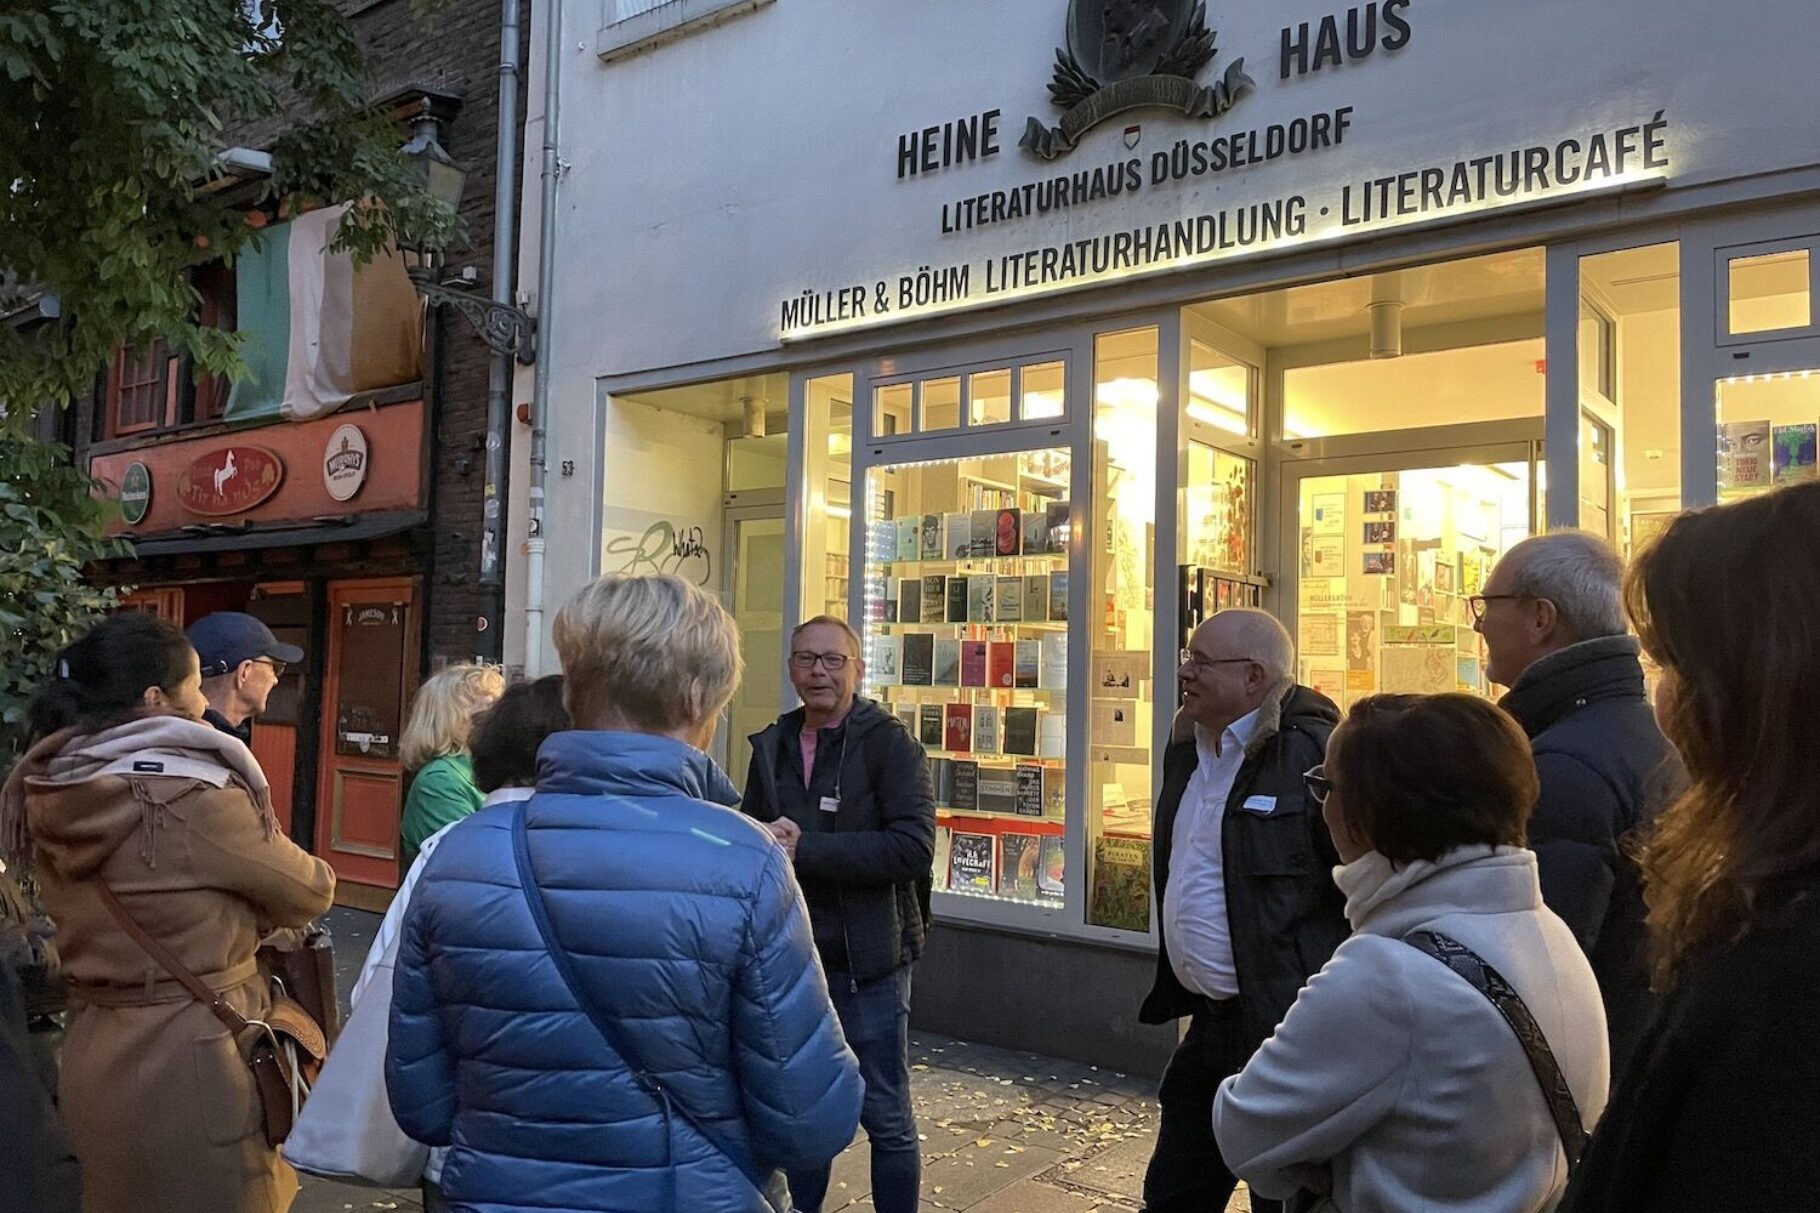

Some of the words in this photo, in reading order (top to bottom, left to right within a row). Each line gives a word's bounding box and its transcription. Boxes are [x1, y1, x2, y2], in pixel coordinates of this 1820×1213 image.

[897, 108, 1000, 179] HEINE
[1279, 0, 1411, 80] HAUS
[781, 289, 866, 331] MÜLLER
[874, 281, 890, 314] &
[898, 266, 970, 310] BÖHM
[986, 195, 1306, 294] LITERATURHANDLUNG
[1341, 109, 1669, 226] LITERATURCAFÉ
[941, 158, 1142, 234] LITERATURHAUS
[1151, 106, 1354, 186] DÜSSELDORF
[562, 460, 575, 476] 53
[953, 856, 991, 868] LOVECRAFT
